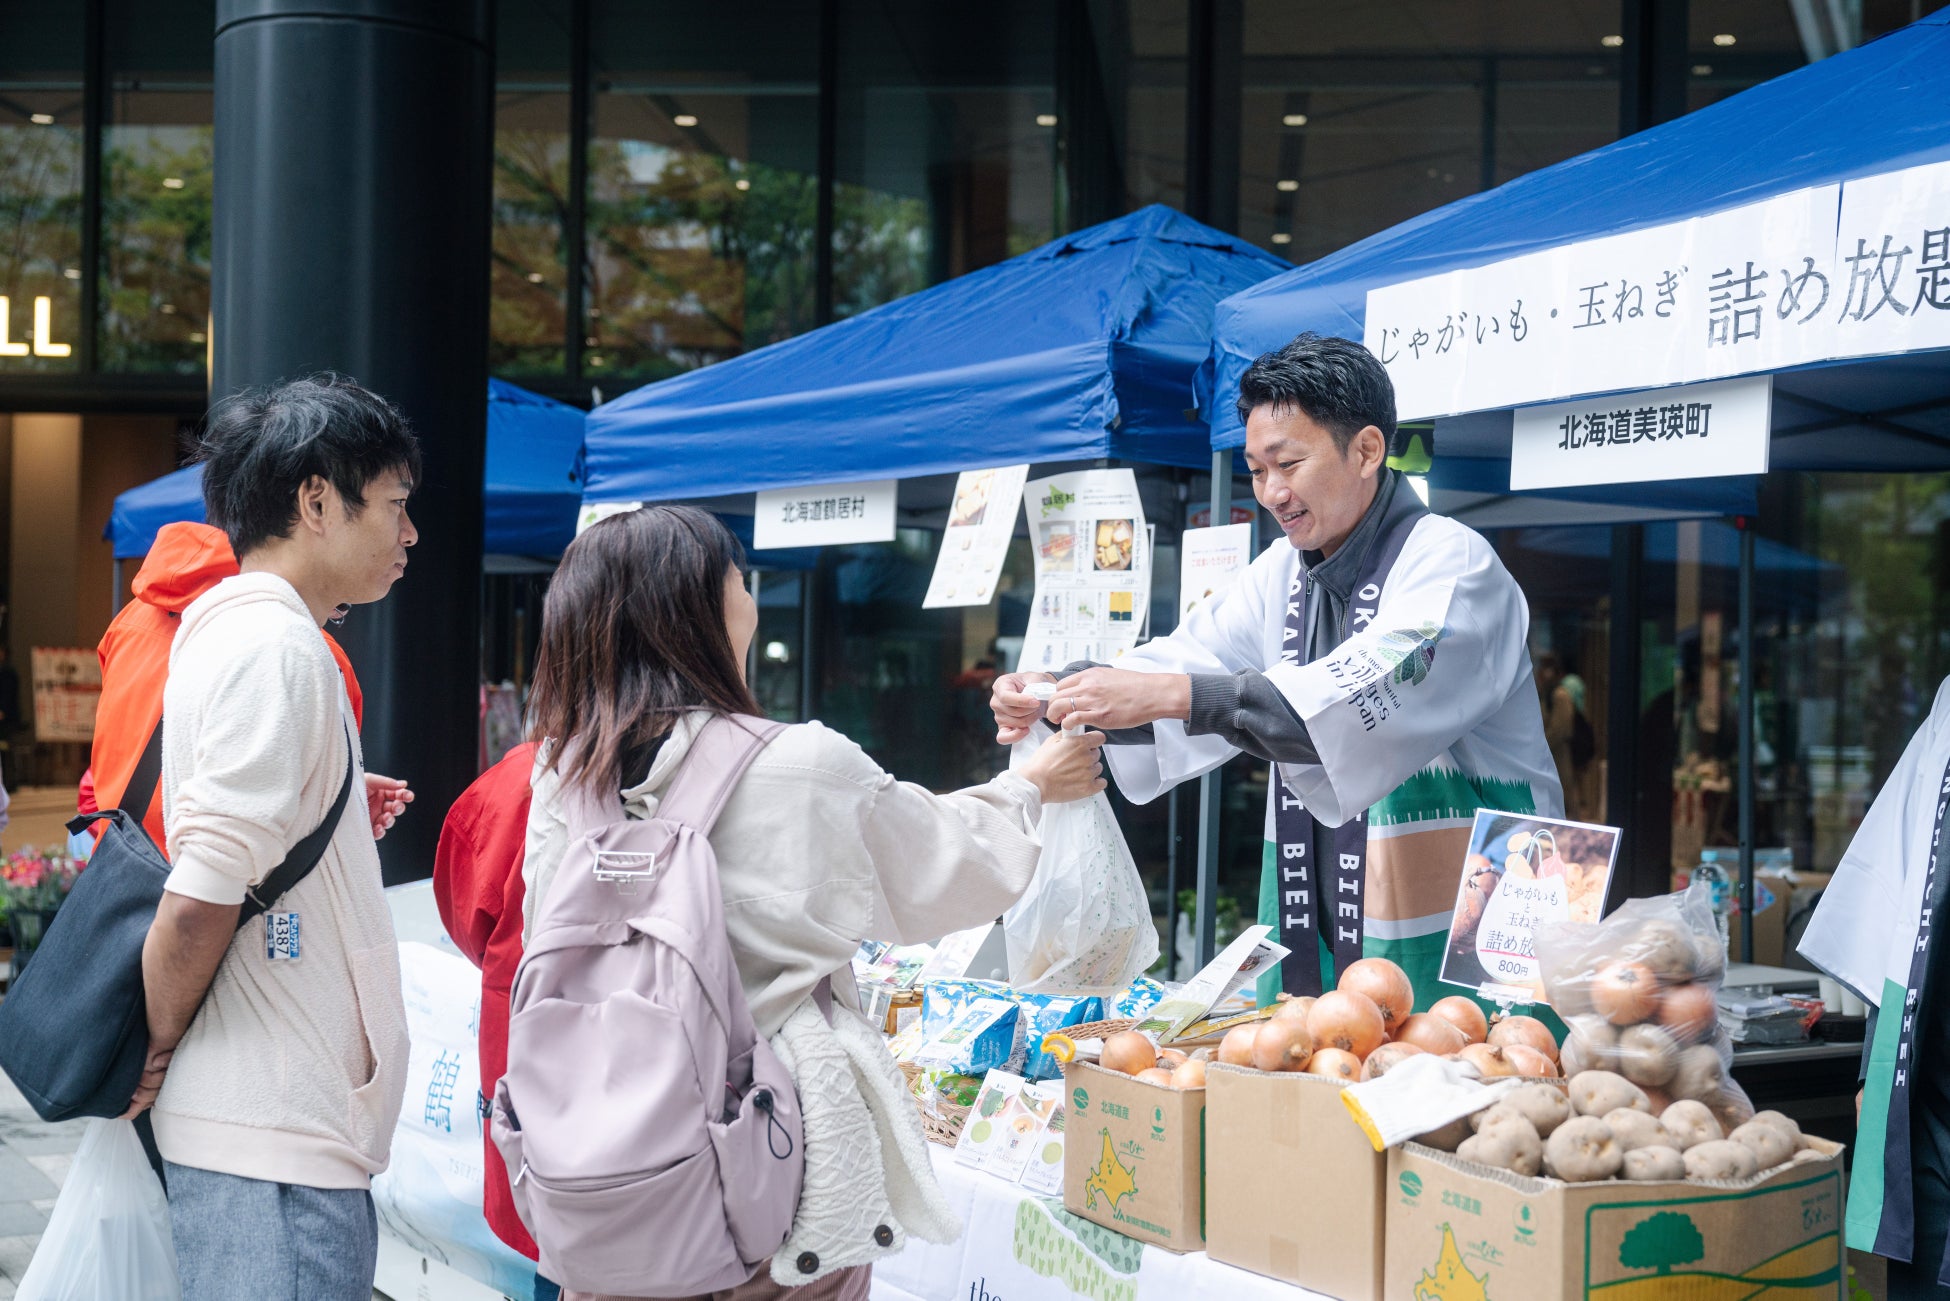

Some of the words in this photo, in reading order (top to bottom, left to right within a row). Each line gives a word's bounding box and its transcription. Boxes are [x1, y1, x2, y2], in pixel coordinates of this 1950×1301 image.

[1558, 403, 1712, 450] 北海道美瑛町
[782, 496, 865, 523] 北海道鶴居村
[1326, 660, 1345, 678] in
[1337, 678, 1377, 732] japan
[1343, 655, 1390, 721] villages
[1283, 843, 1309, 929] BIEI
[1338, 853, 1360, 944] BIEI
[1502, 883, 1559, 905] じゃがいも
[1506, 912, 1544, 931] 玉ねぎ
[1524, 903, 1532, 912] と
[276, 917, 289, 955] 4387
[1498, 959, 1529, 976] 800円
[1895, 988, 1917, 1086] BIEI
[1100, 1100, 1130, 1121] 北海道産
